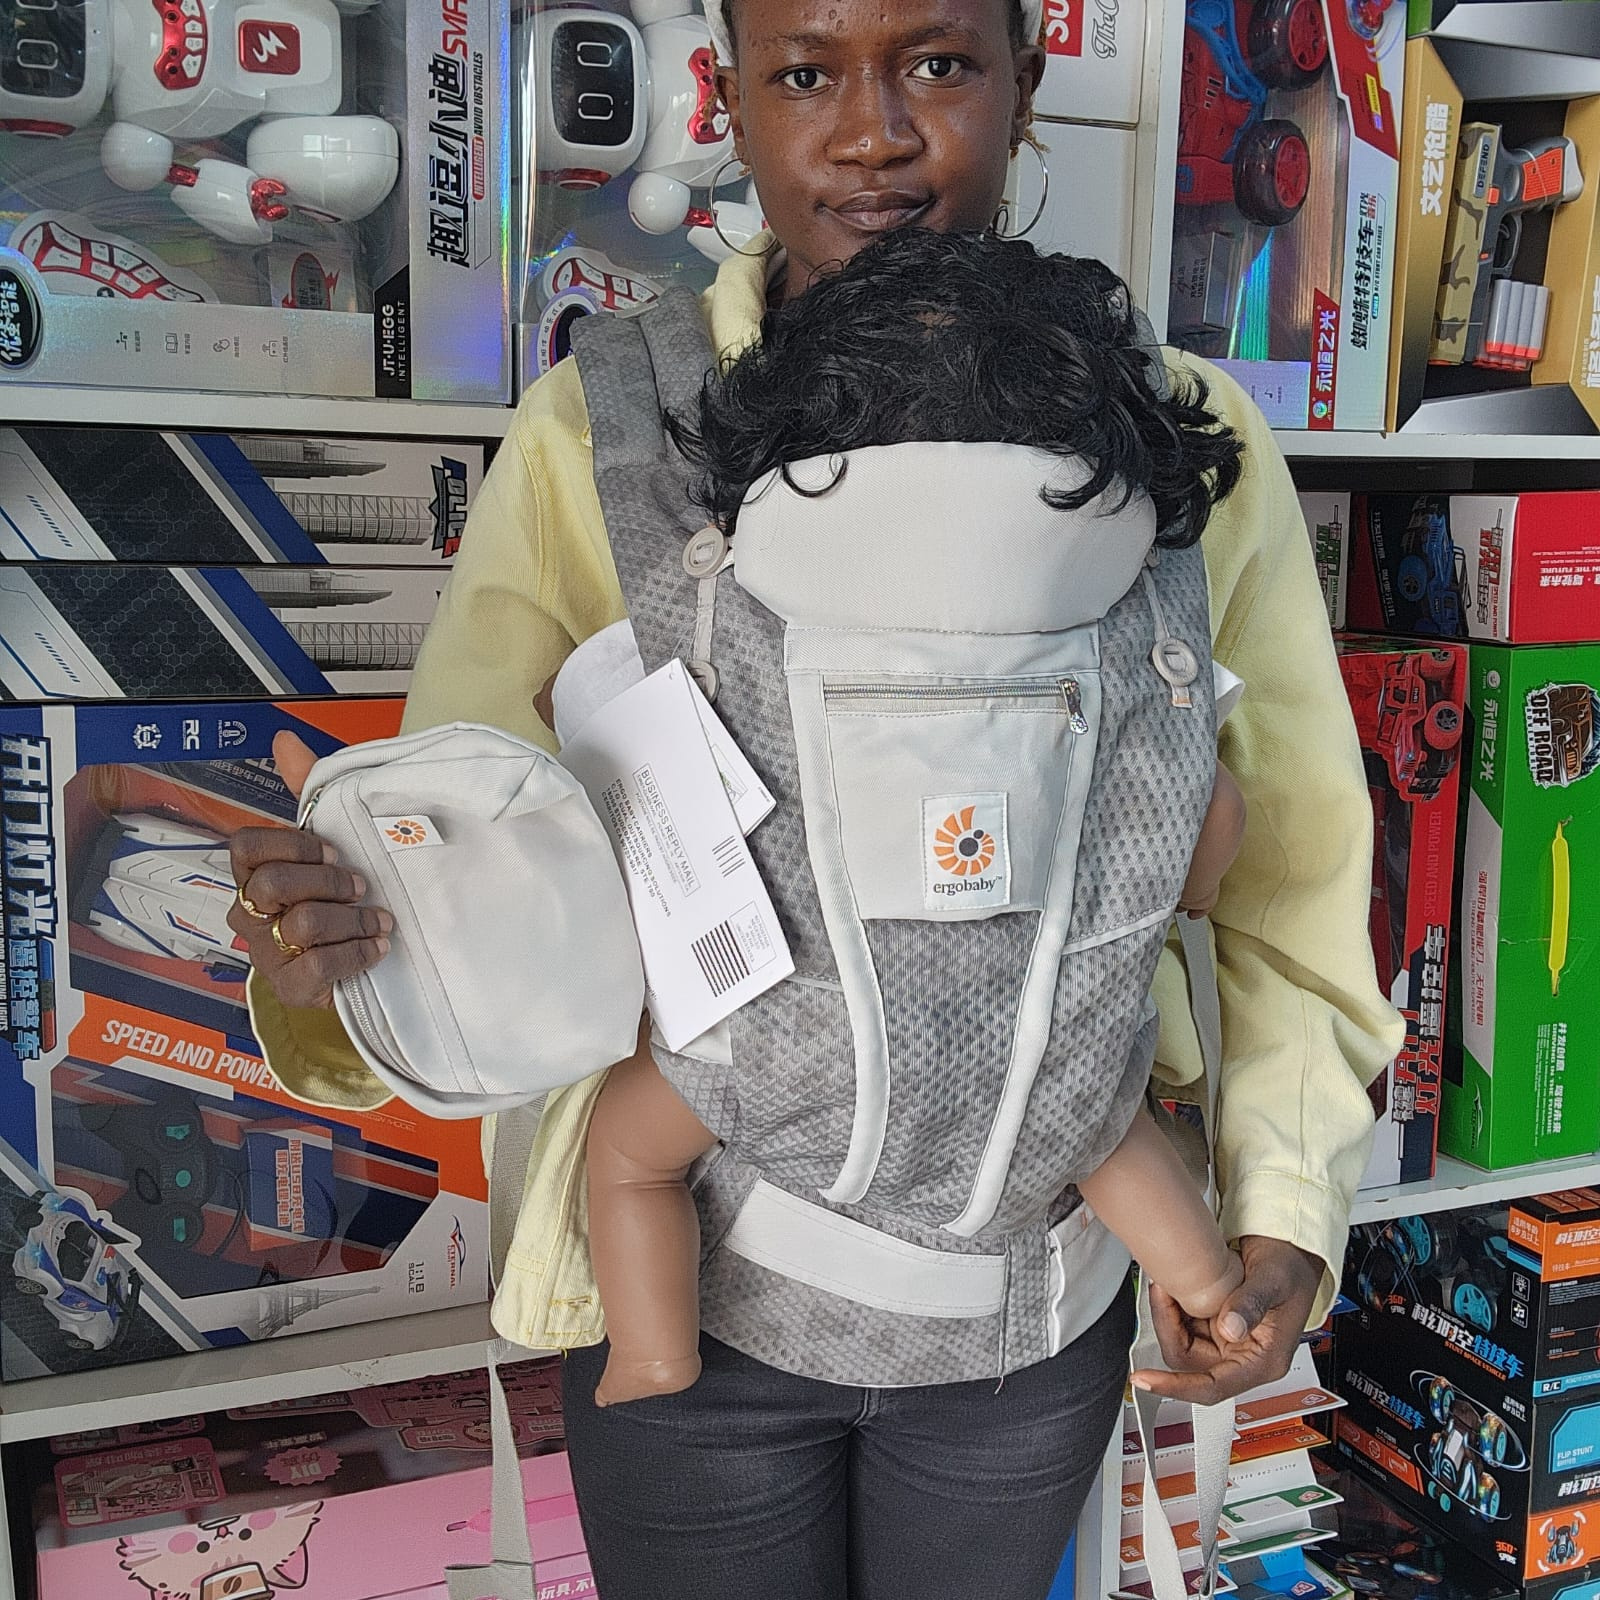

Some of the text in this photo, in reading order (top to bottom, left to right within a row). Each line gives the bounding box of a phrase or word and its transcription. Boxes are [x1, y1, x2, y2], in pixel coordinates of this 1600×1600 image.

[427, 52, 470, 268] 趣逗小迪
[473, 52, 484, 196] INTELLIGENT AVOID OBSTACLES
[1420, 103, 1448, 216] 文艺枪酷
[1478, 144, 1490, 188] DEFEND
[1350, 217, 1374, 350] 蜘蛛特技车
[398, 300, 406, 382] INTELLIGENT
[1315, 310, 1336, 392] 永恒之光
[442, 457, 466, 559] POLICE
[1480, 699, 1498, 781] 永恒之光
[1531, 694, 1553, 783] OFF ROAD
[614, 778, 653, 858] ERGO BABY CARRIERS
[640, 769, 696, 887] BUSINESS REPLY MAIL
[933, 878, 996, 896] ergobaby
[1423, 811, 1441, 917] SPEED AND POWER
[0, 1002, 8, 1031] LIGHTS
[102, 1020, 166, 1058] SPEED
[167, 1039, 216, 1069] AND
[1415, 924, 1445, 1115] 灯光遥控车
[416, 1262, 424, 1293] 1:18
[1473, 1334, 1525, 1380] 特技车
[1543, 1382, 1560, 1392] R/C
[1557, 1445, 1593, 1460] FLIP STUNT
